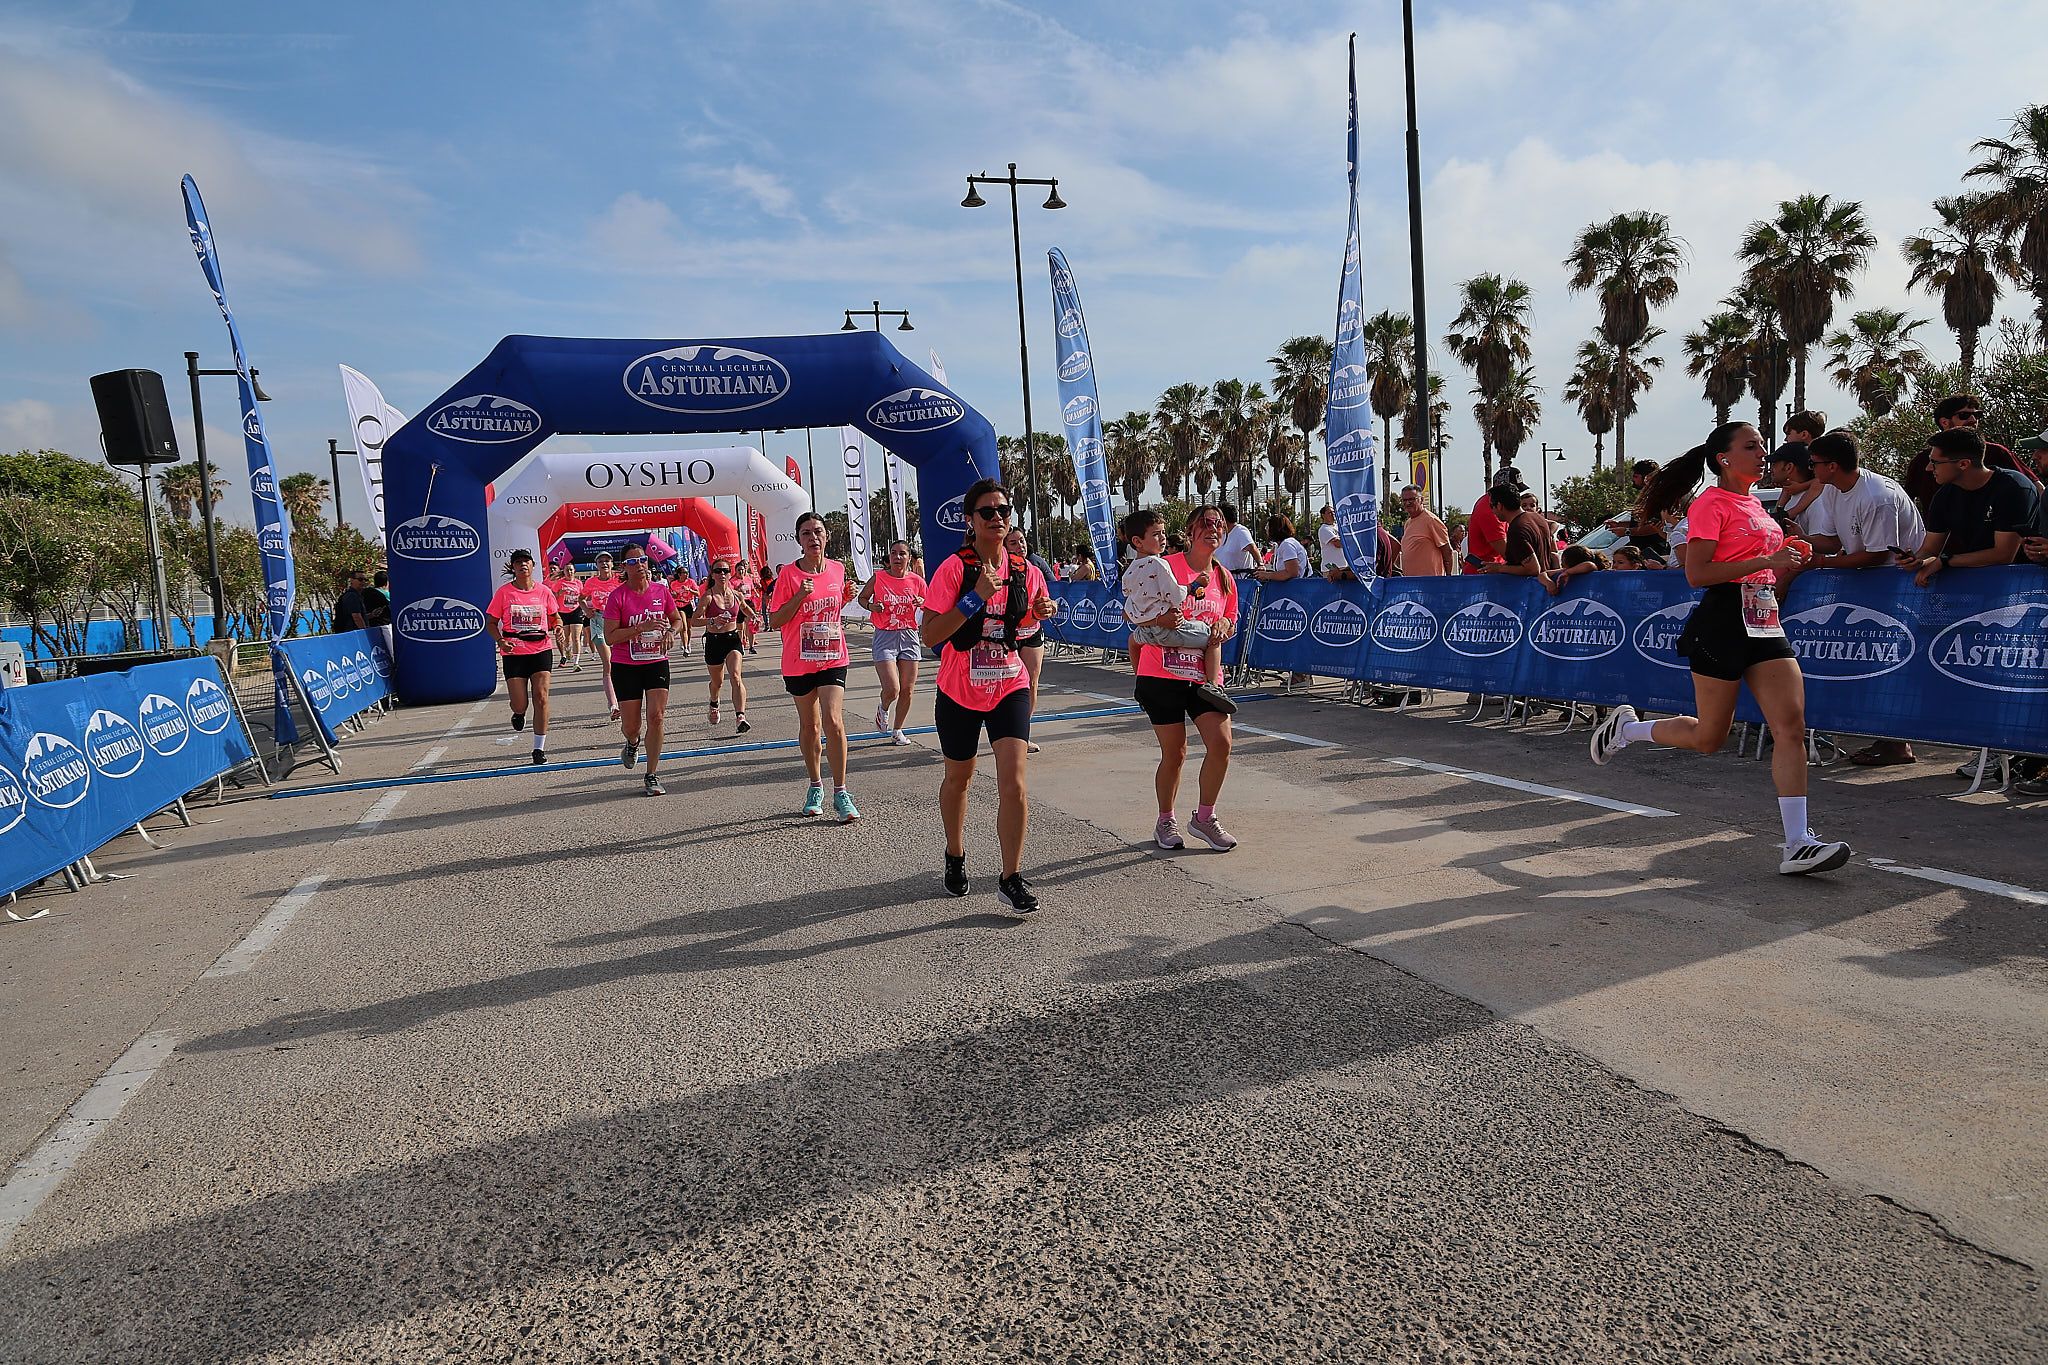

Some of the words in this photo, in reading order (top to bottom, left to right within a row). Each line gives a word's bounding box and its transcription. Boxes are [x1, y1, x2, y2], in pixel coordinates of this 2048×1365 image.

[662, 364, 714, 372] CENTRAL
[720, 364, 772, 372] LECHERA
[637, 365, 780, 396] ASTURIANA
[434, 412, 533, 432] ASTURIANA
[493, 411, 532, 419] LECHERA
[875, 405, 960, 424] ASTURIANA
[585, 459, 715, 489] OYSHO
[751, 482, 789, 493] OYSHO
[507, 495, 548, 505] OYSHO
[572, 507, 607, 520] Sports
[623, 503, 677, 515] Santander
[396, 532, 475, 550] ASTURIANA
[775, 532, 795, 542] OYS
[802, 596, 840, 614] CARRERA
[401, 614, 481, 632] ASTURIANA
[1257, 613, 1302, 632] ASTURIANA
[1313, 616, 1362, 636] ASTURIANA
[1374, 618, 1432, 640] ASTURIANA
[1447, 620, 1515, 643] ASTURIANA
[1551, 619, 1582, 627] CENTRAL
[1534, 620, 1617, 646] ASTURIANA
[1793, 628, 1842, 637] CENTRAL
[1847, 629, 1899, 639] LECHERA
[1974, 631, 2035, 642] CENTRAL
[813, 639, 830, 647] 016
[1791, 639, 1902, 663] STURIANA
[1940, 633, 2048, 670] ASTURI
[990, 649, 1004, 659] 01
[1179, 653, 1198, 663] 016
[92, 735, 142, 768] ASTURIANA
